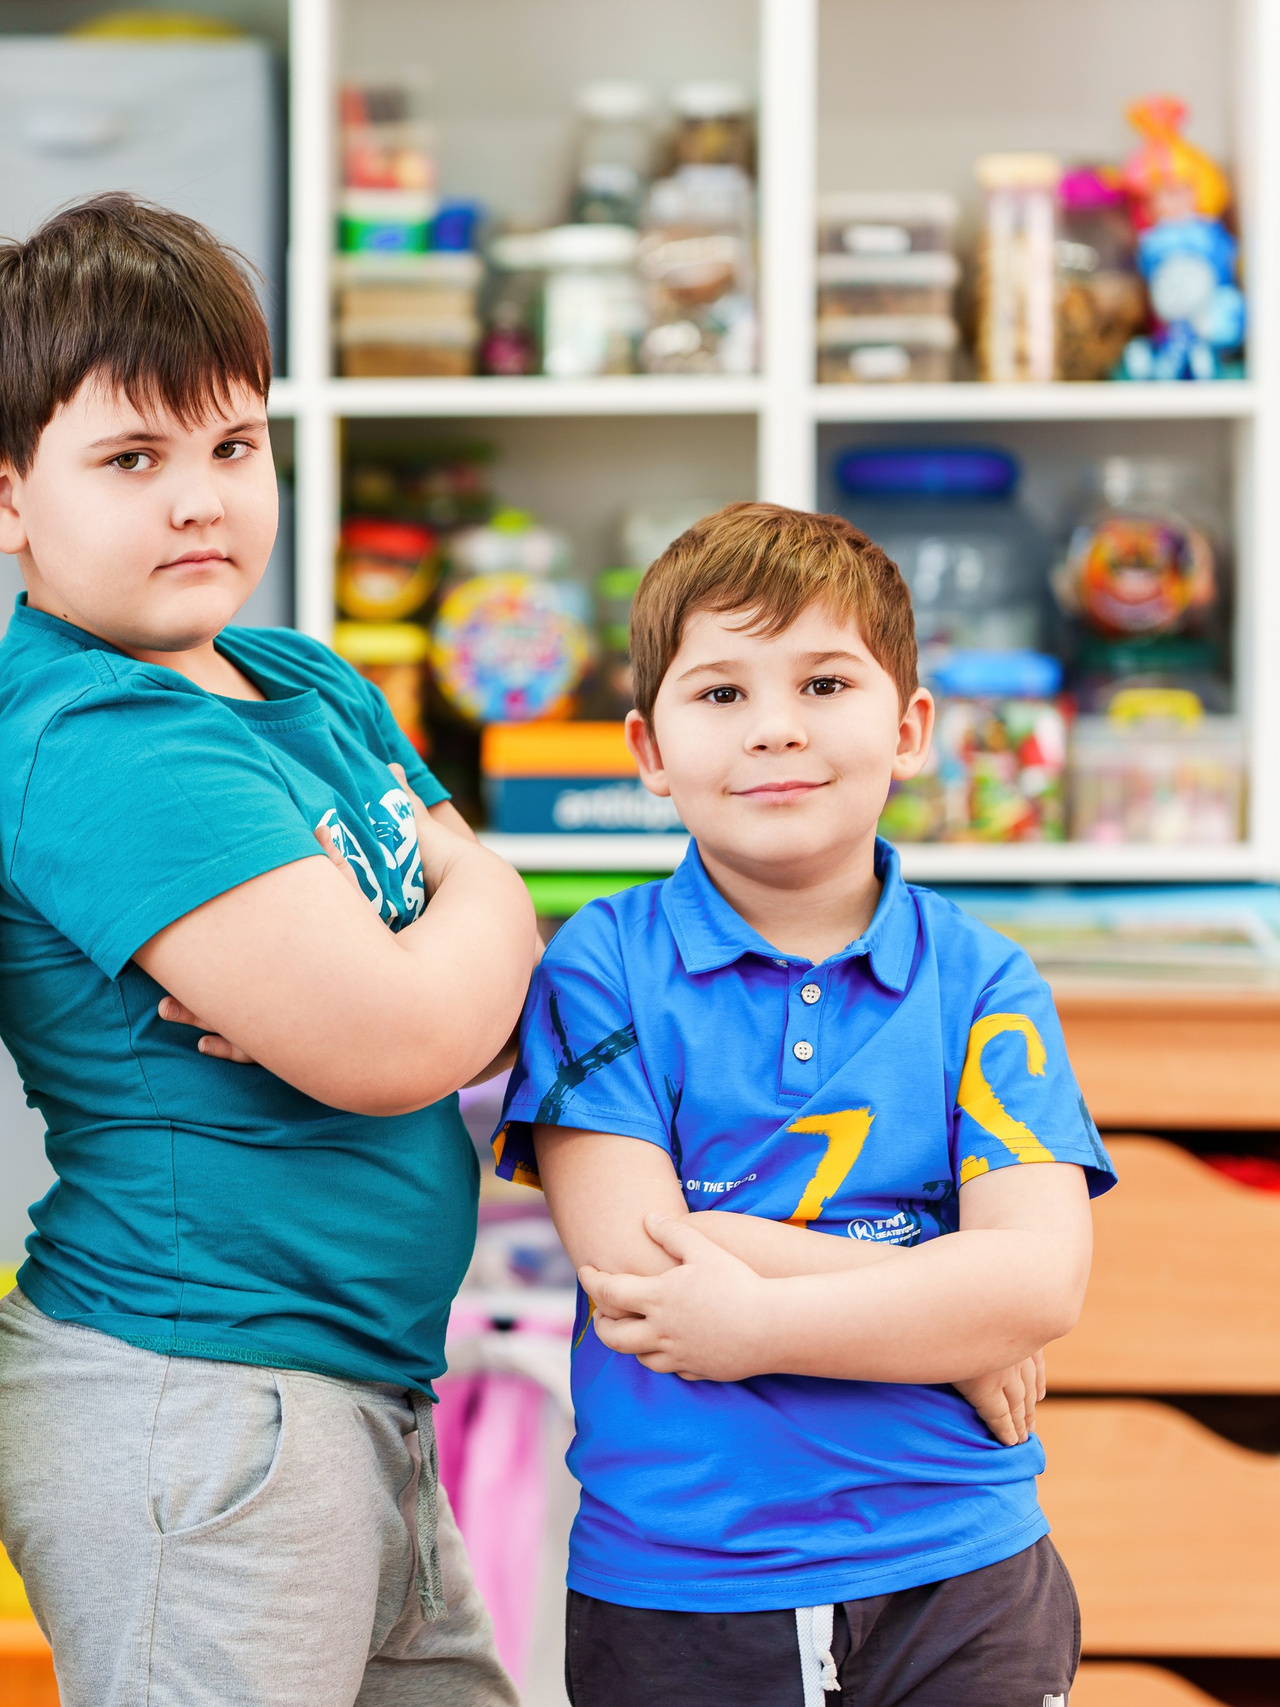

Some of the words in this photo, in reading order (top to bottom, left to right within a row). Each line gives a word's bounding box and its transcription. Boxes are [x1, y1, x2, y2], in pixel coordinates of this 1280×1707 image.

[686, 1179, 701, 1191] ON
[703, 1181, 725, 1193] THE
[873, 1211, 907, 1230] TNT
